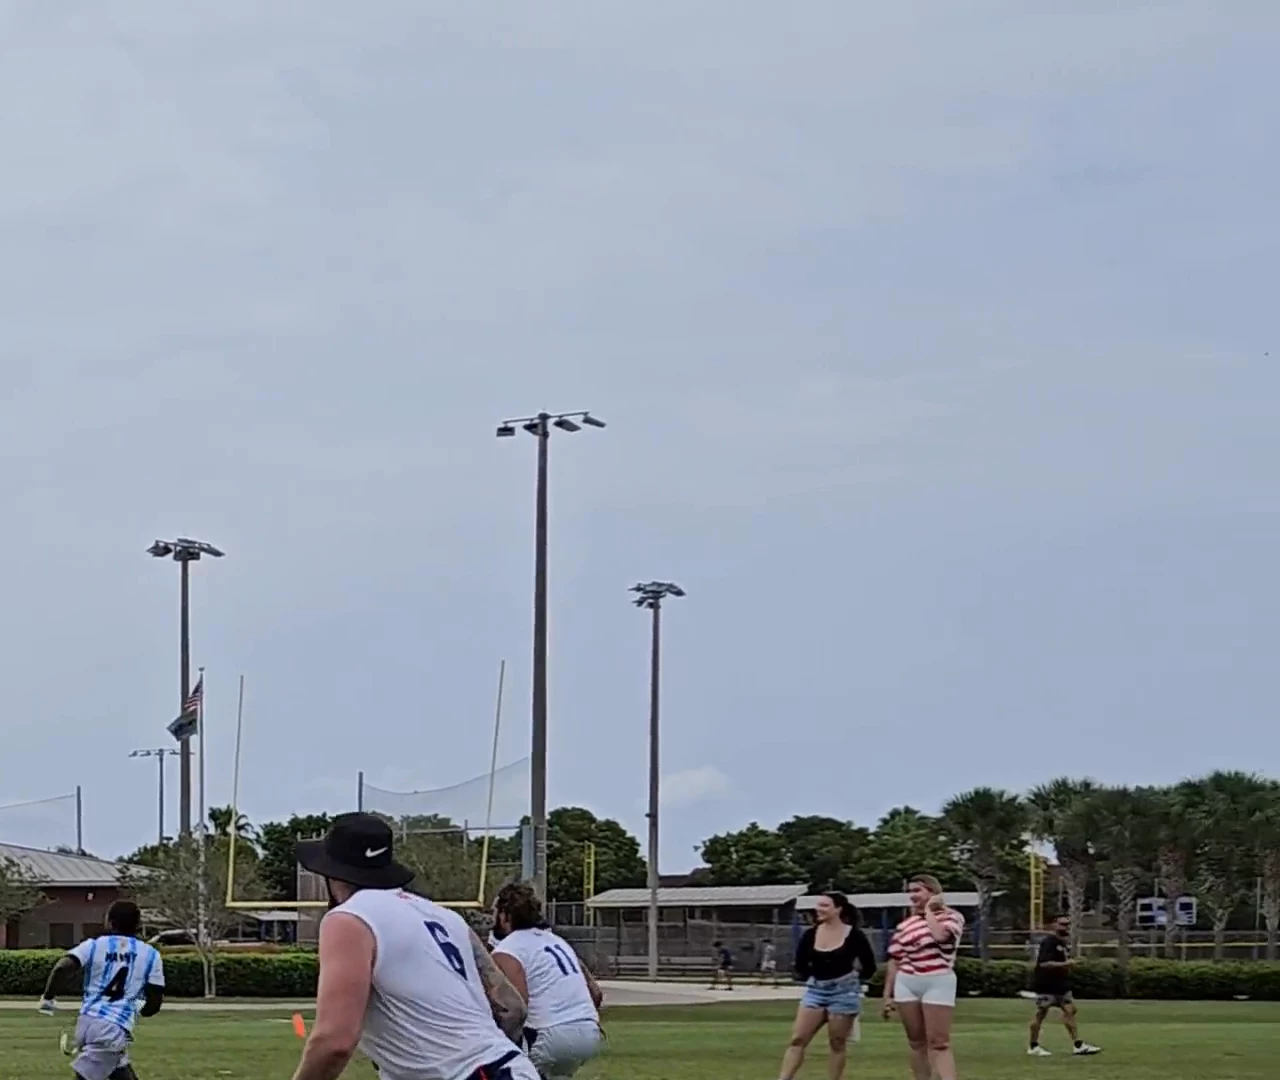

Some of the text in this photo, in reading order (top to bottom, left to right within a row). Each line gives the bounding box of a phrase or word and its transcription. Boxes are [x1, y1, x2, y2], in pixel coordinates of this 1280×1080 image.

[424, 920, 468, 981] 6
[544, 944, 579, 976] 11
[100, 967, 129, 1002] 4
